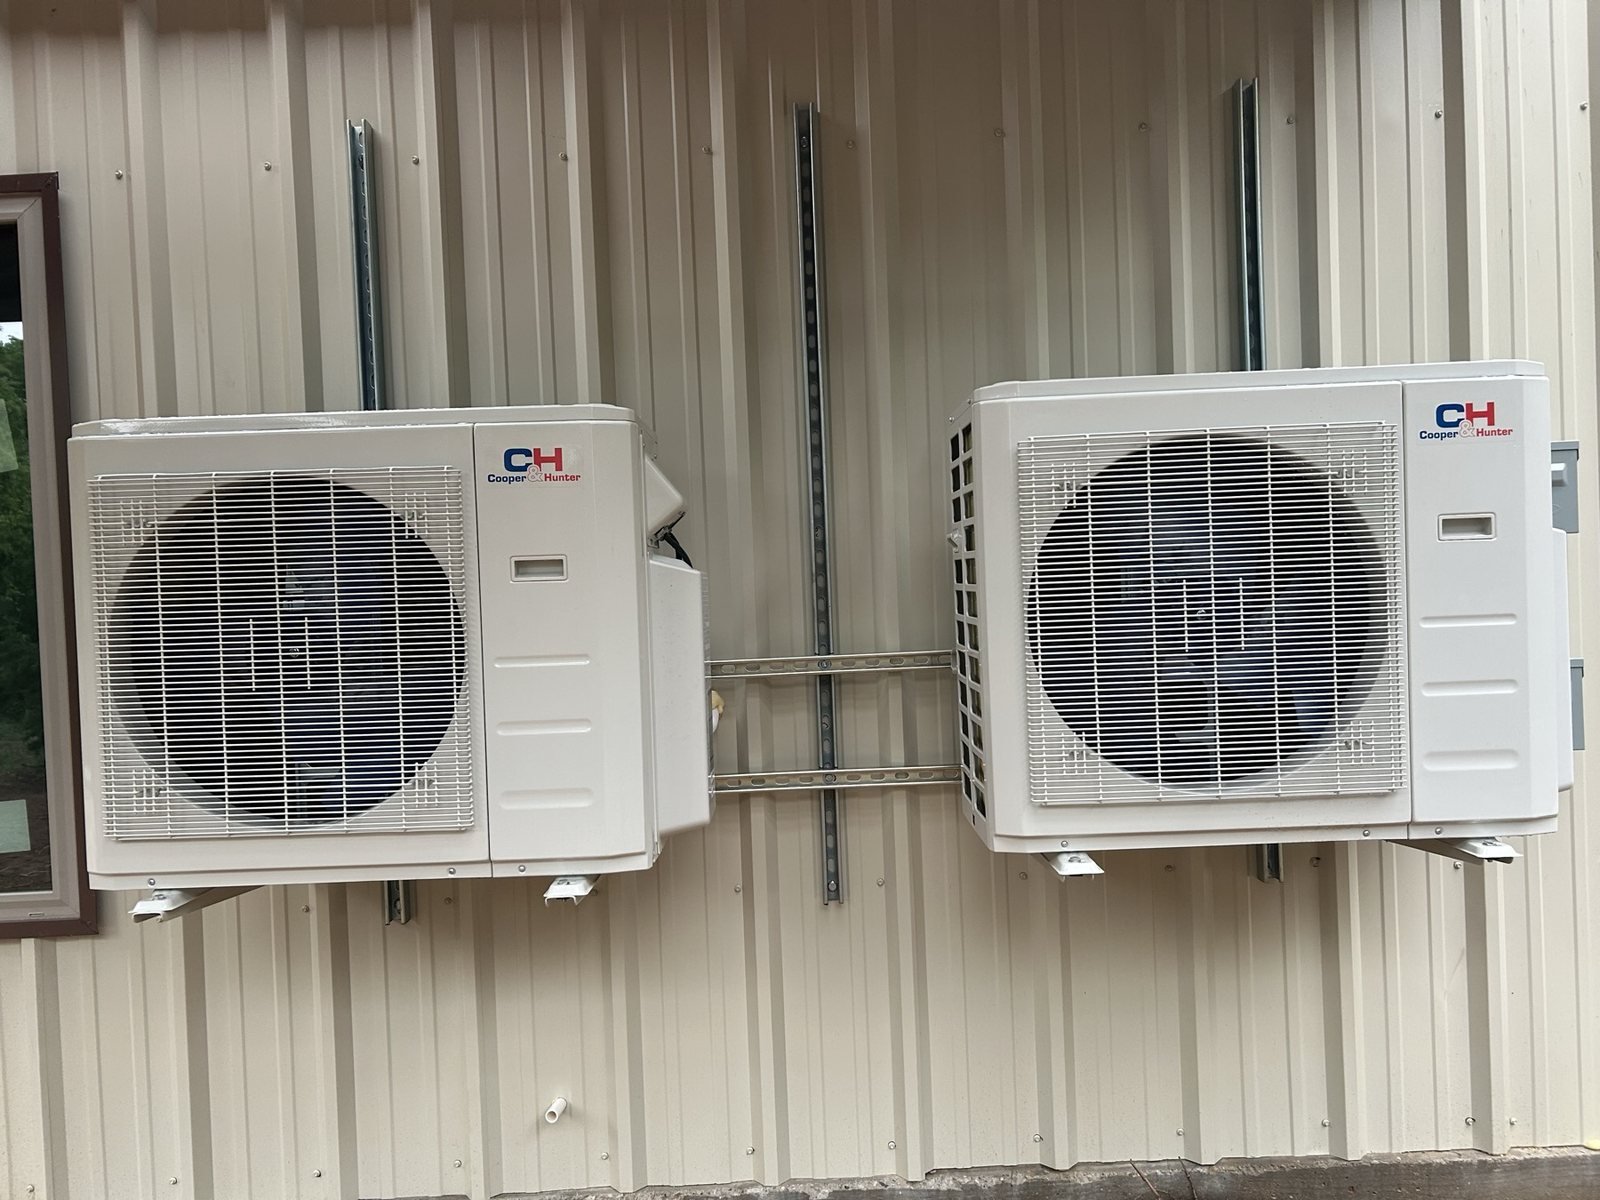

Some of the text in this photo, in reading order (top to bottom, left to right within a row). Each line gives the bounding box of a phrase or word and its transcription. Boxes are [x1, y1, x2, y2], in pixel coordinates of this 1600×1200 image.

[1436, 402, 1495, 428] CH
[1420, 430, 1459, 441] Cooper
[1476, 428, 1513, 437] Hunter
[504, 448, 563, 472] CH
[488, 474, 527, 484] Cooper
[544, 473, 581, 482] Hunter
